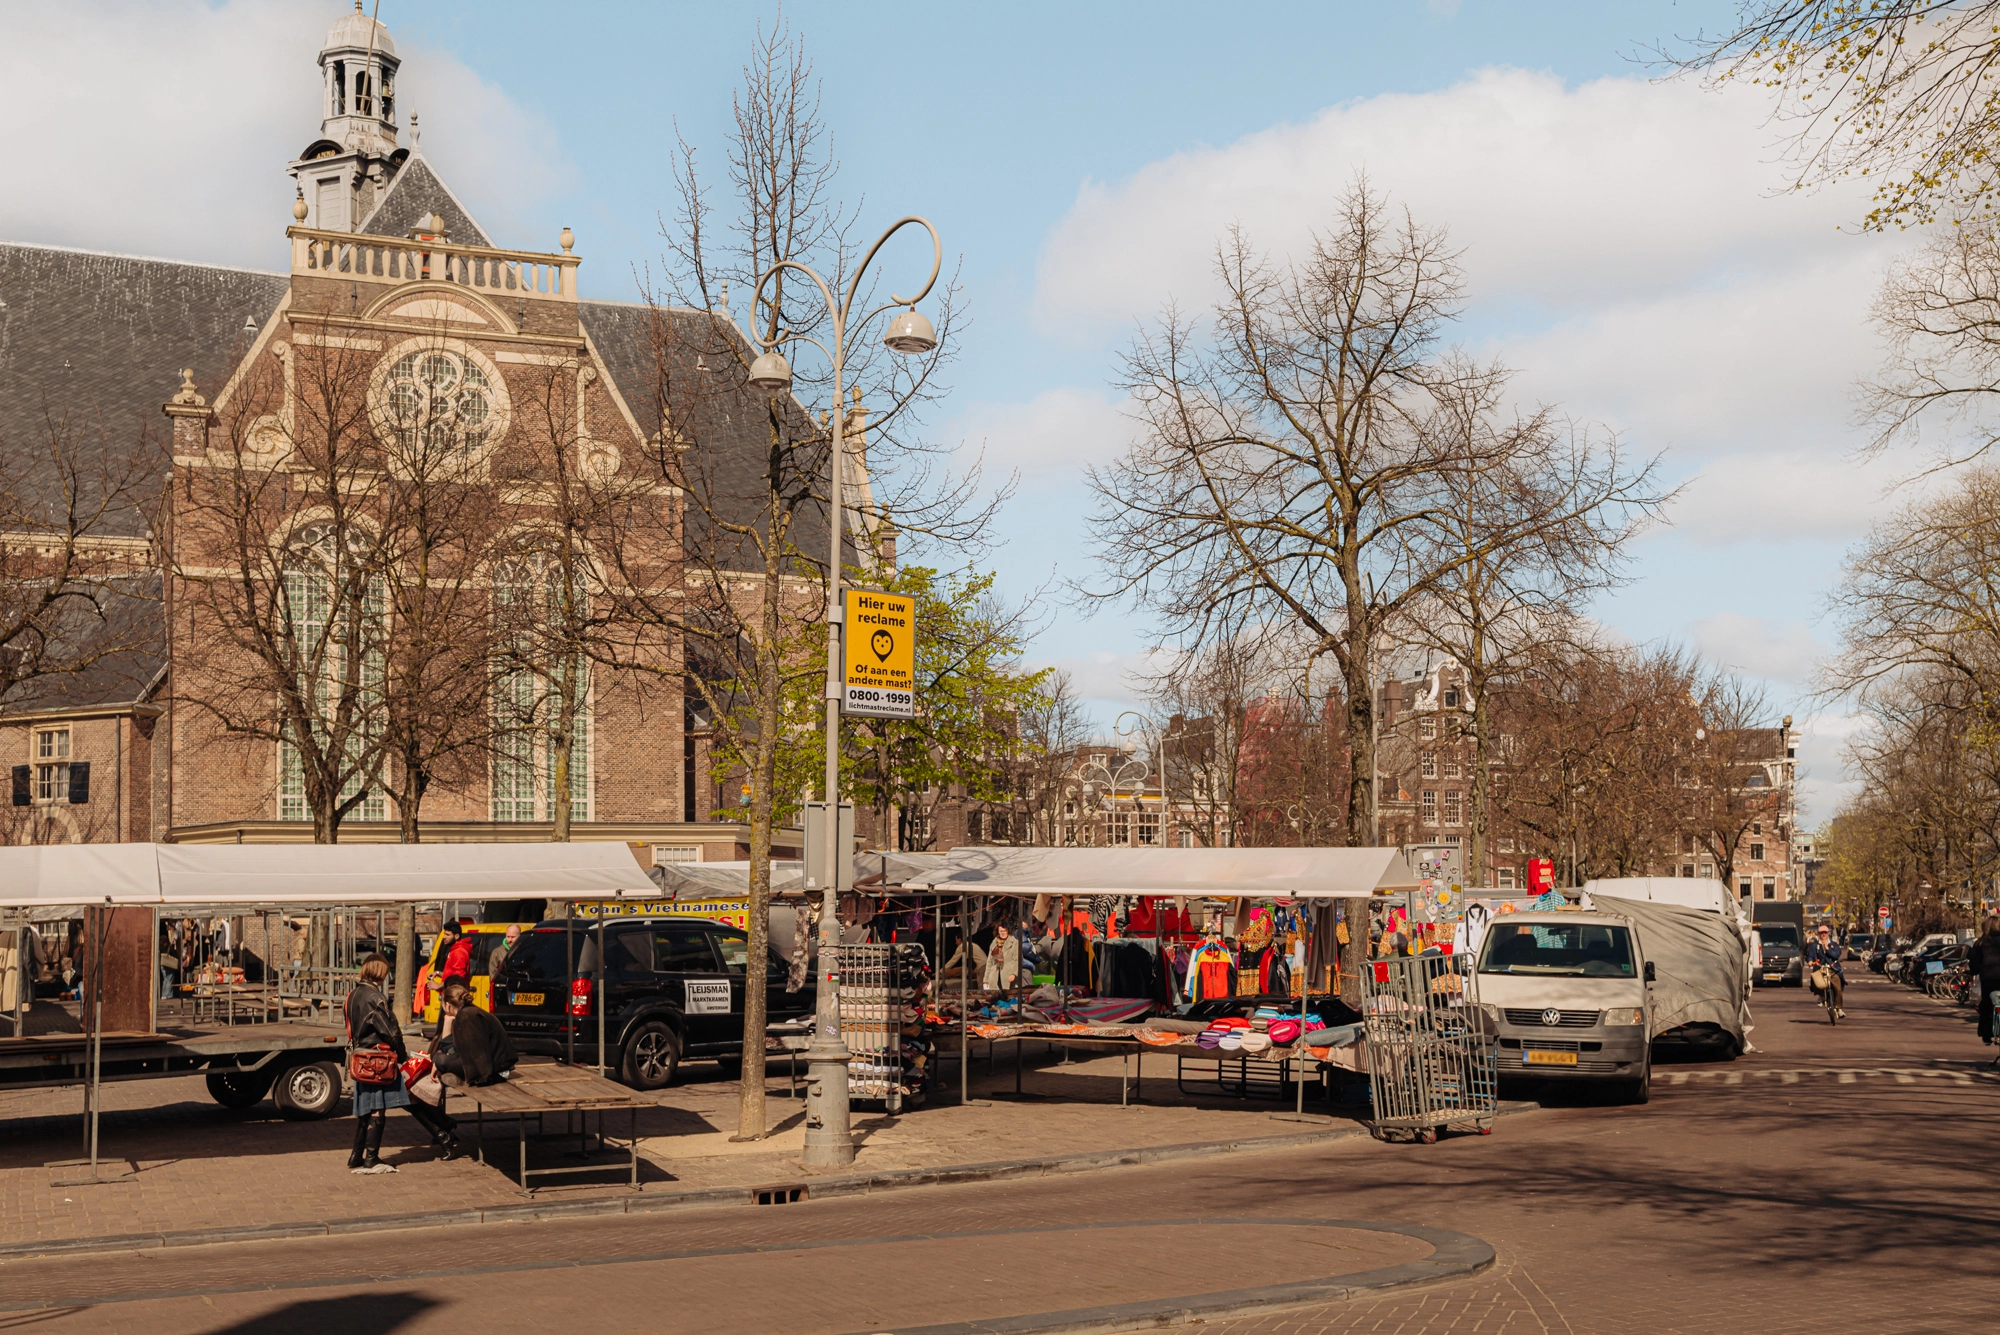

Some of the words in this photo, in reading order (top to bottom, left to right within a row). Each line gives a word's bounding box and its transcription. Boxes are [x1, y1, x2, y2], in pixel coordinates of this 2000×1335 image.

[859, 597, 884, 610] Hier
[888, 603, 905, 612] uw
[858, 614, 905, 627] reclame
[855, 665, 868, 673] Of
[871, 667, 887, 675] aan
[890, 669, 906, 677] een
[849, 676, 883, 686] andere
[886, 679, 912, 689] mast?
[850, 690, 910, 704] 0800-1999
[849, 703, 911, 713] lichtmastreclame.nl
[579, 904, 638, 914] Toan's
[643, 902, 750, 913] Vietnamese
[691, 985, 729, 994] LEIJSMAN
